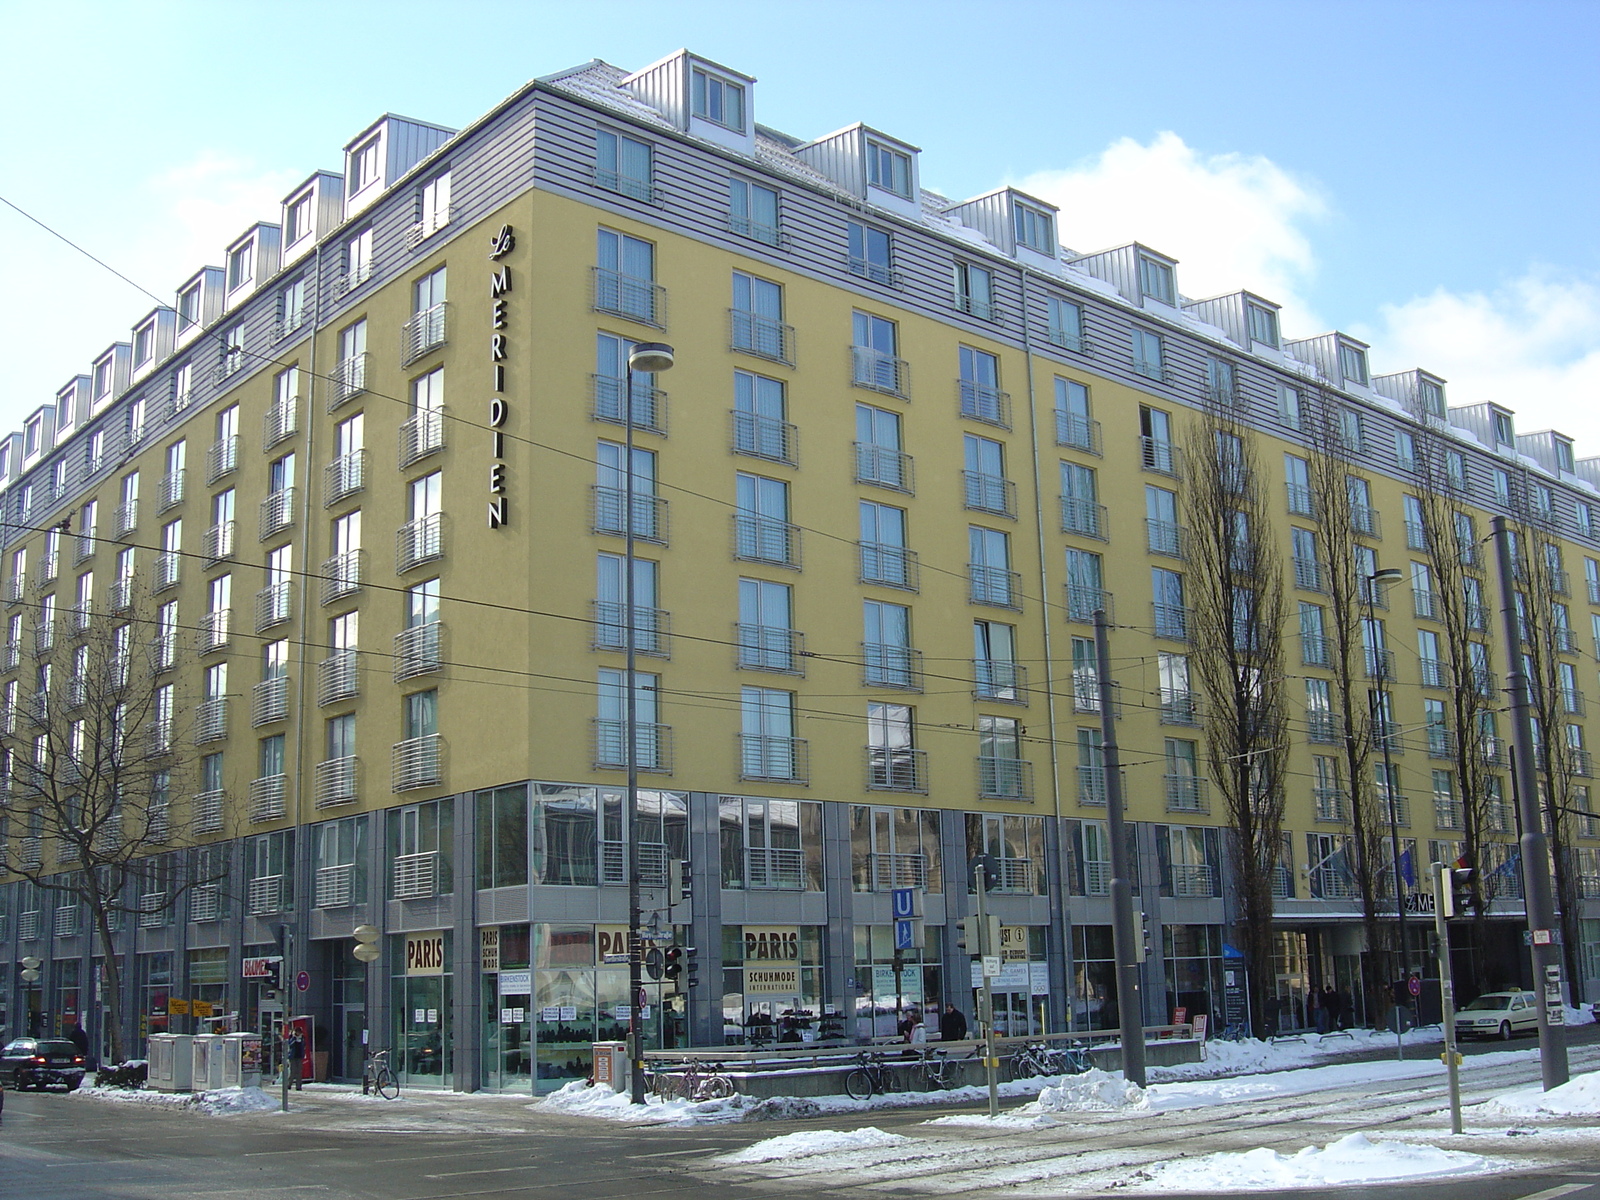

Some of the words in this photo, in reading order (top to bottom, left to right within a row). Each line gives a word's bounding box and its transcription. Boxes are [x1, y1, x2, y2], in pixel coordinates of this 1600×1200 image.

[488, 223, 516, 261] Le
[488, 265, 513, 529] MERIDIEN
[896, 892, 911, 915] U
[483, 930, 498, 947] PARIS
[745, 932, 798, 961] PARIS
[408, 937, 443, 969] PARIS
[483, 947, 498, 958] SCHUH
[483, 959, 498, 969] MODE
[875, 969, 916, 978] BIRKEOCK
[749, 971, 796, 982] SCHUHMODE
